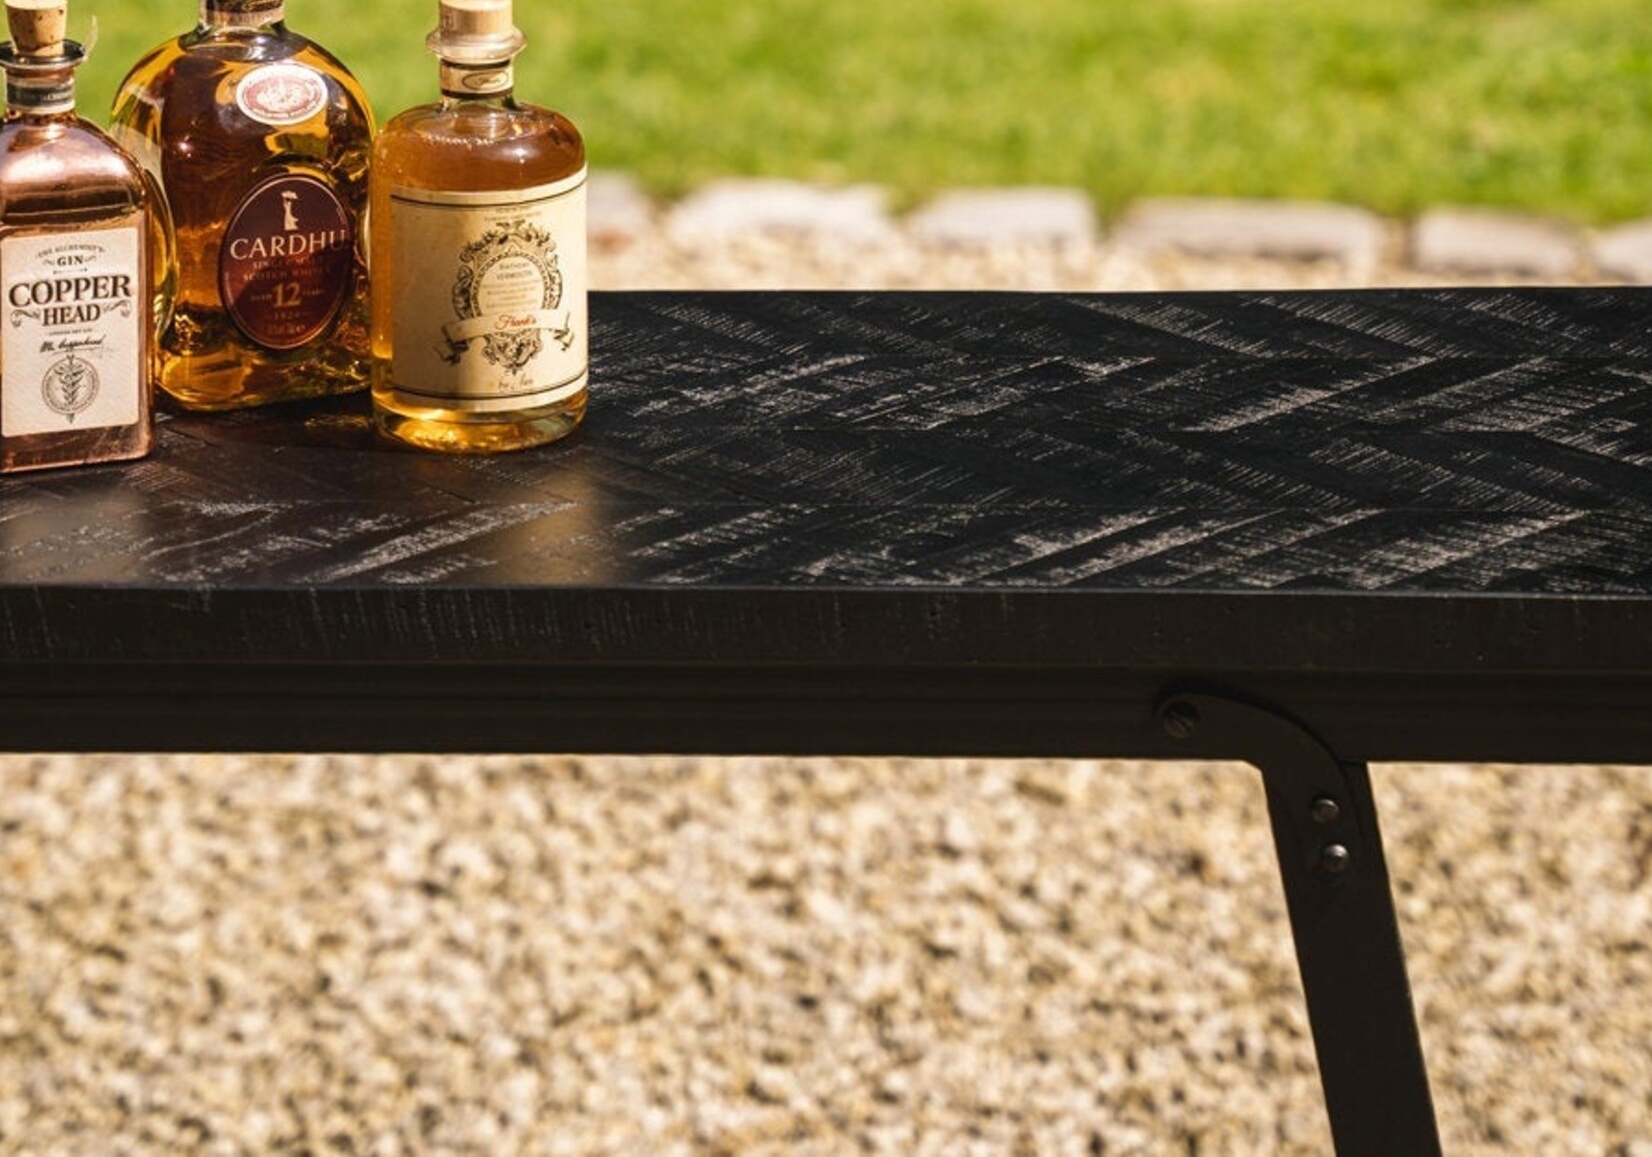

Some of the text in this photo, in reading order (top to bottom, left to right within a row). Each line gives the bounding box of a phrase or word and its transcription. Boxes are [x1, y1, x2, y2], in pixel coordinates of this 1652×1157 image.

[230, 229, 346, 261] CARDHU
[57, 255, 83, 266] GIN
[8, 274, 131, 308] COPPER
[272, 282, 301, 308] 12
[42, 304, 101, 326] HEAD
